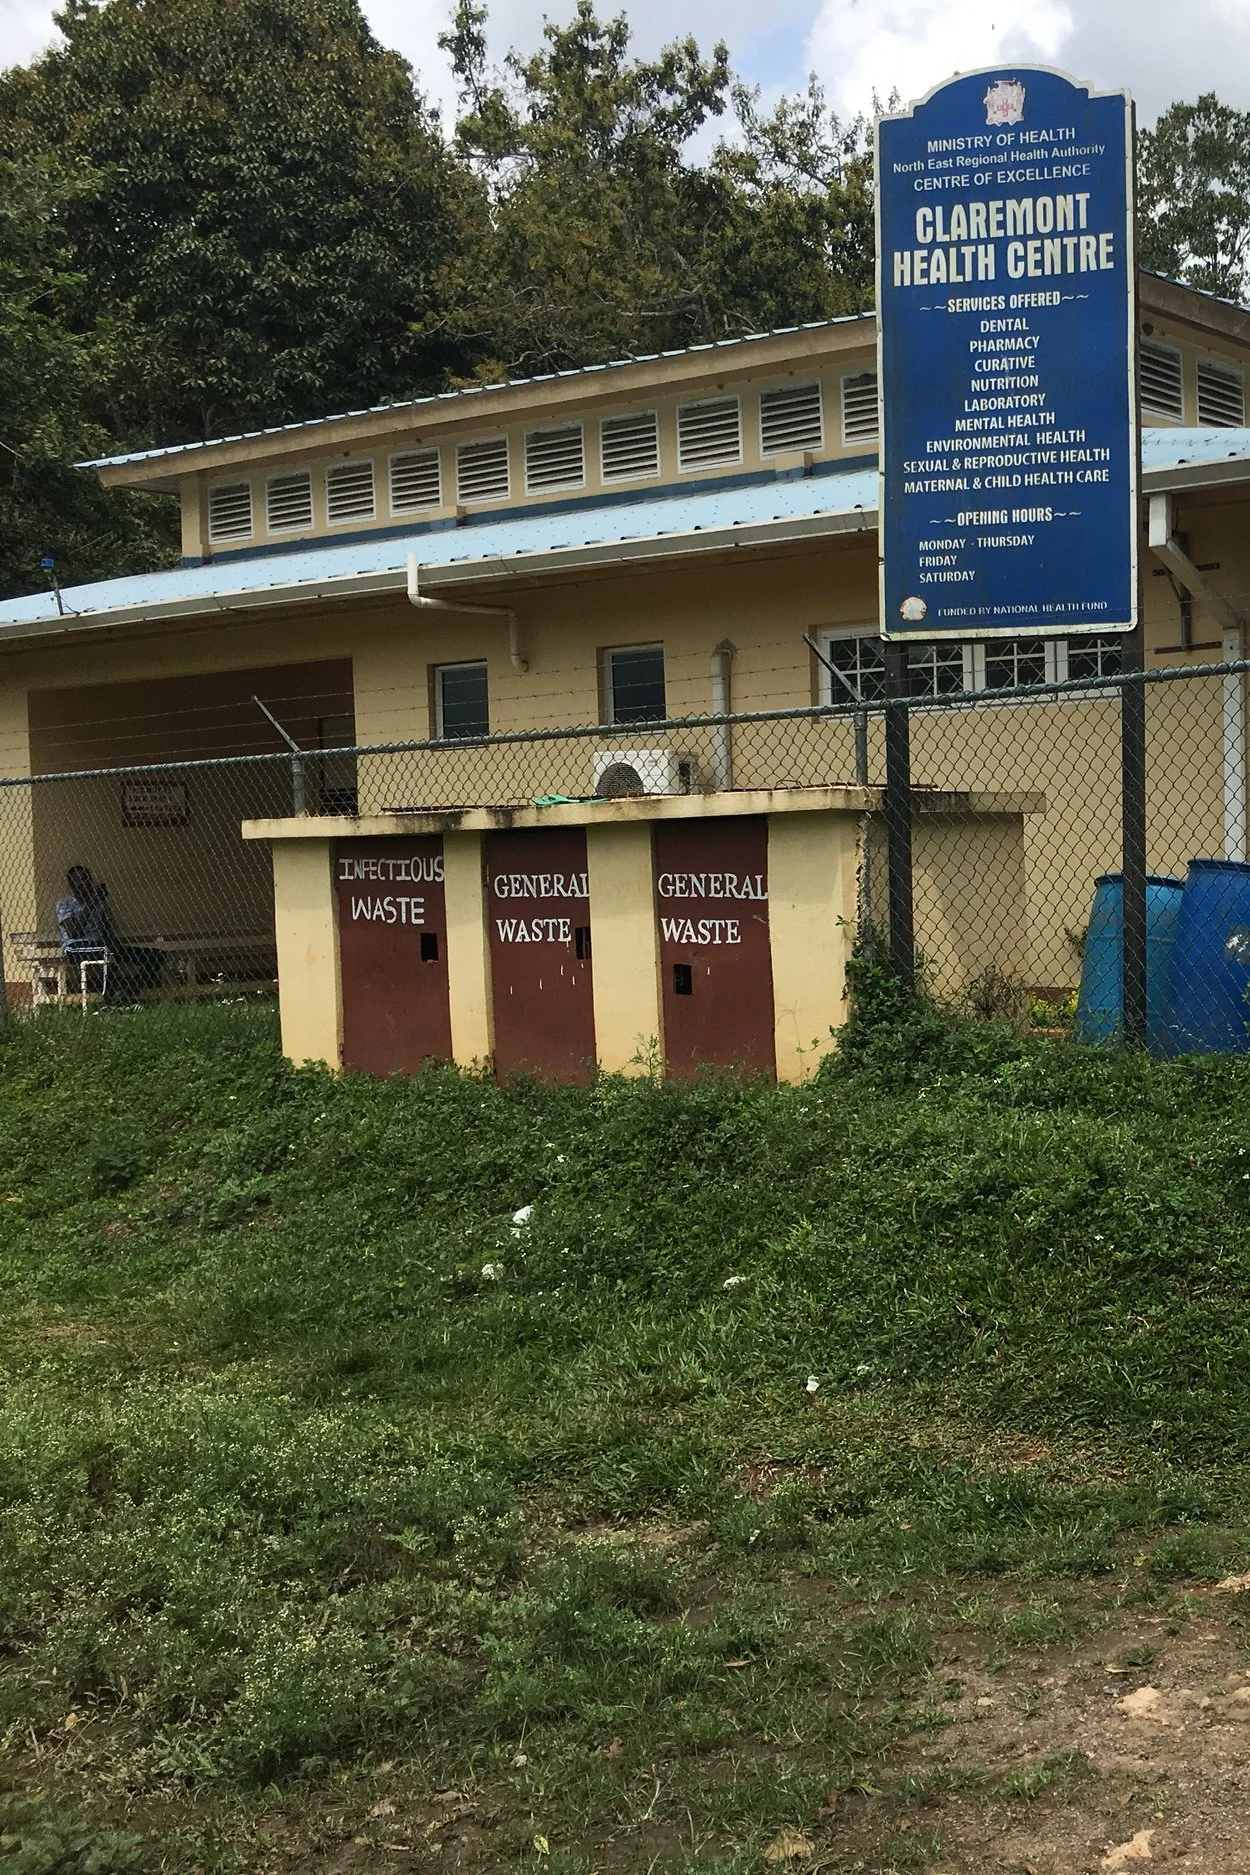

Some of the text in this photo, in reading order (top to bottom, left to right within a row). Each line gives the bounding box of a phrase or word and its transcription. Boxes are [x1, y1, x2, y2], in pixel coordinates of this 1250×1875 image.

[927, 128, 1075, 153] MINISTRY OF HEALTH
[893, 144, 1105, 173] North East Regional Health Authority
[914, 164, 1091, 192] CENTRE OF EXCELLENCE
[916, 193, 1090, 244] CLAREMONT
[894, 233, 1115, 286] HEALTH CENTRE
[948, 291, 1060, 313] SERVICES OFFERED
[980, 318, 1029, 333] DENTAL
[970, 336, 1040, 353] PHARMACY
[974, 356, 1035, 372] CURATIVE
[971, 375, 1039, 392] NUTRITION
[964, 394, 1046, 412] LABORATORY
[955, 412, 1055, 432] MENTAL HEALTH
[926, 430, 1085, 453] ENVIRONMENTAL HEALTH
[904, 448, 1110, 474] SEXUAL & REPRODUCTIVE HEALTH
[904, 470, 1109, 494] MATERNAL & CHILD HEALTH CARE
[957, 507, 1053, 527] OPENING HOURS
[919, 539, 966, 551] MONDAY
[977, 535, 1035, 548] THURSDAY
[919, 556, 957, 567] FRIDAY
[919, 571, 976, 584] SATURDAY
[938, 602, 1107, 617] FUNDED BY NATIONAL HEALTH FUND
[339, 856, 445, 882] INFECTIOUS
[494, 873, 590, 898] GENERAL
[658, 873, 768, 900] GENERAL
[352, 896, 424, 924] WASTE
[496, 918, 571, 943] WASTE
[661, 918, 741, 944] WASTE
